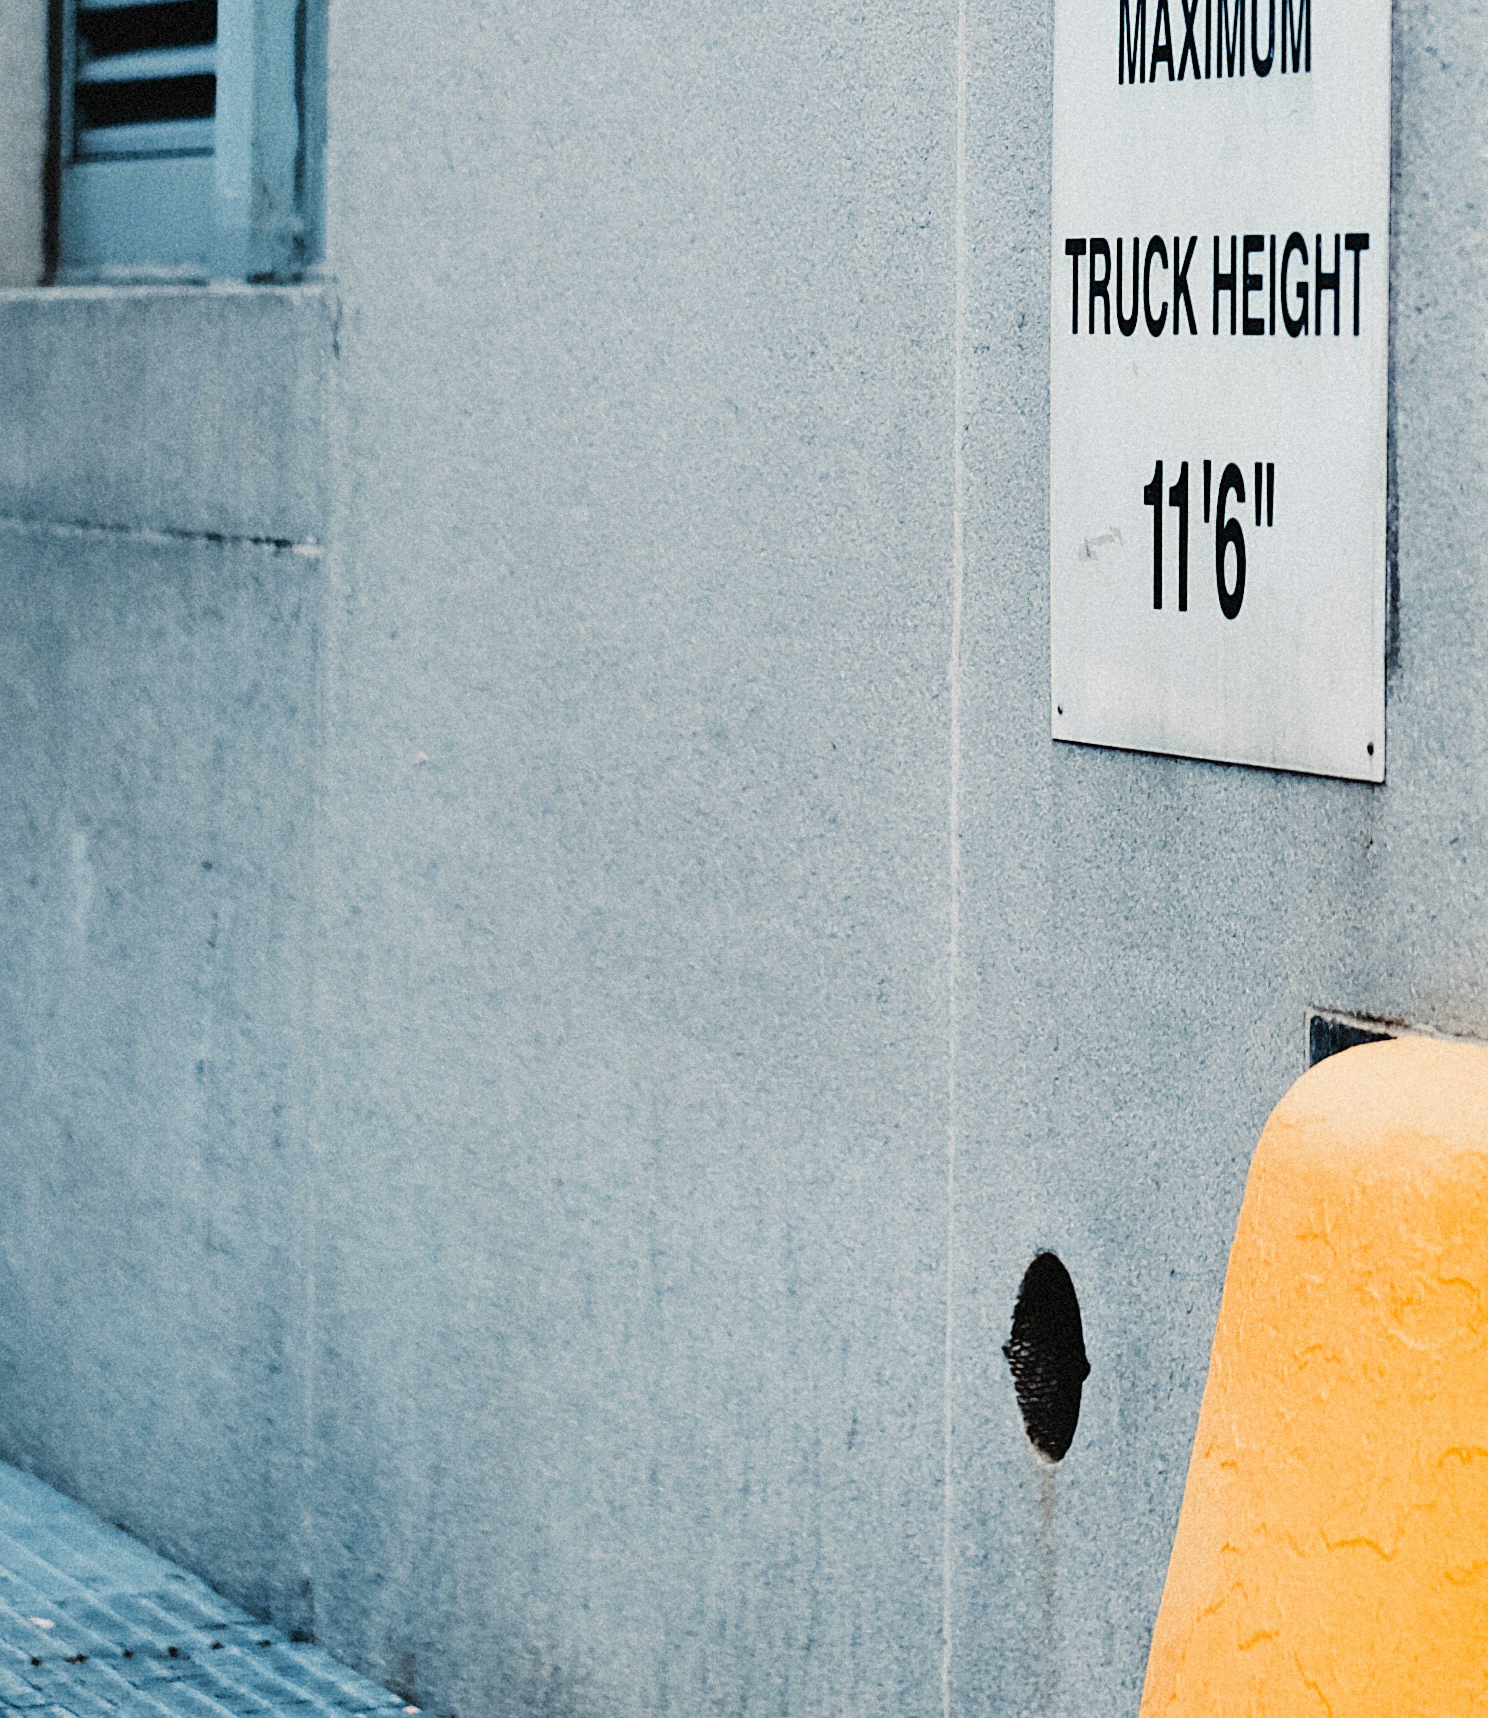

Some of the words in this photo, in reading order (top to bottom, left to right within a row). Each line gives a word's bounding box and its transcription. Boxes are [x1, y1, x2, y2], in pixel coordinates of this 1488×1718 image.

[1064, 235, 1199, 338] TRUCK
[1211, 231, 1371, 339] HEIGHT
[1143, 459, 1275, 620] 11'6"
